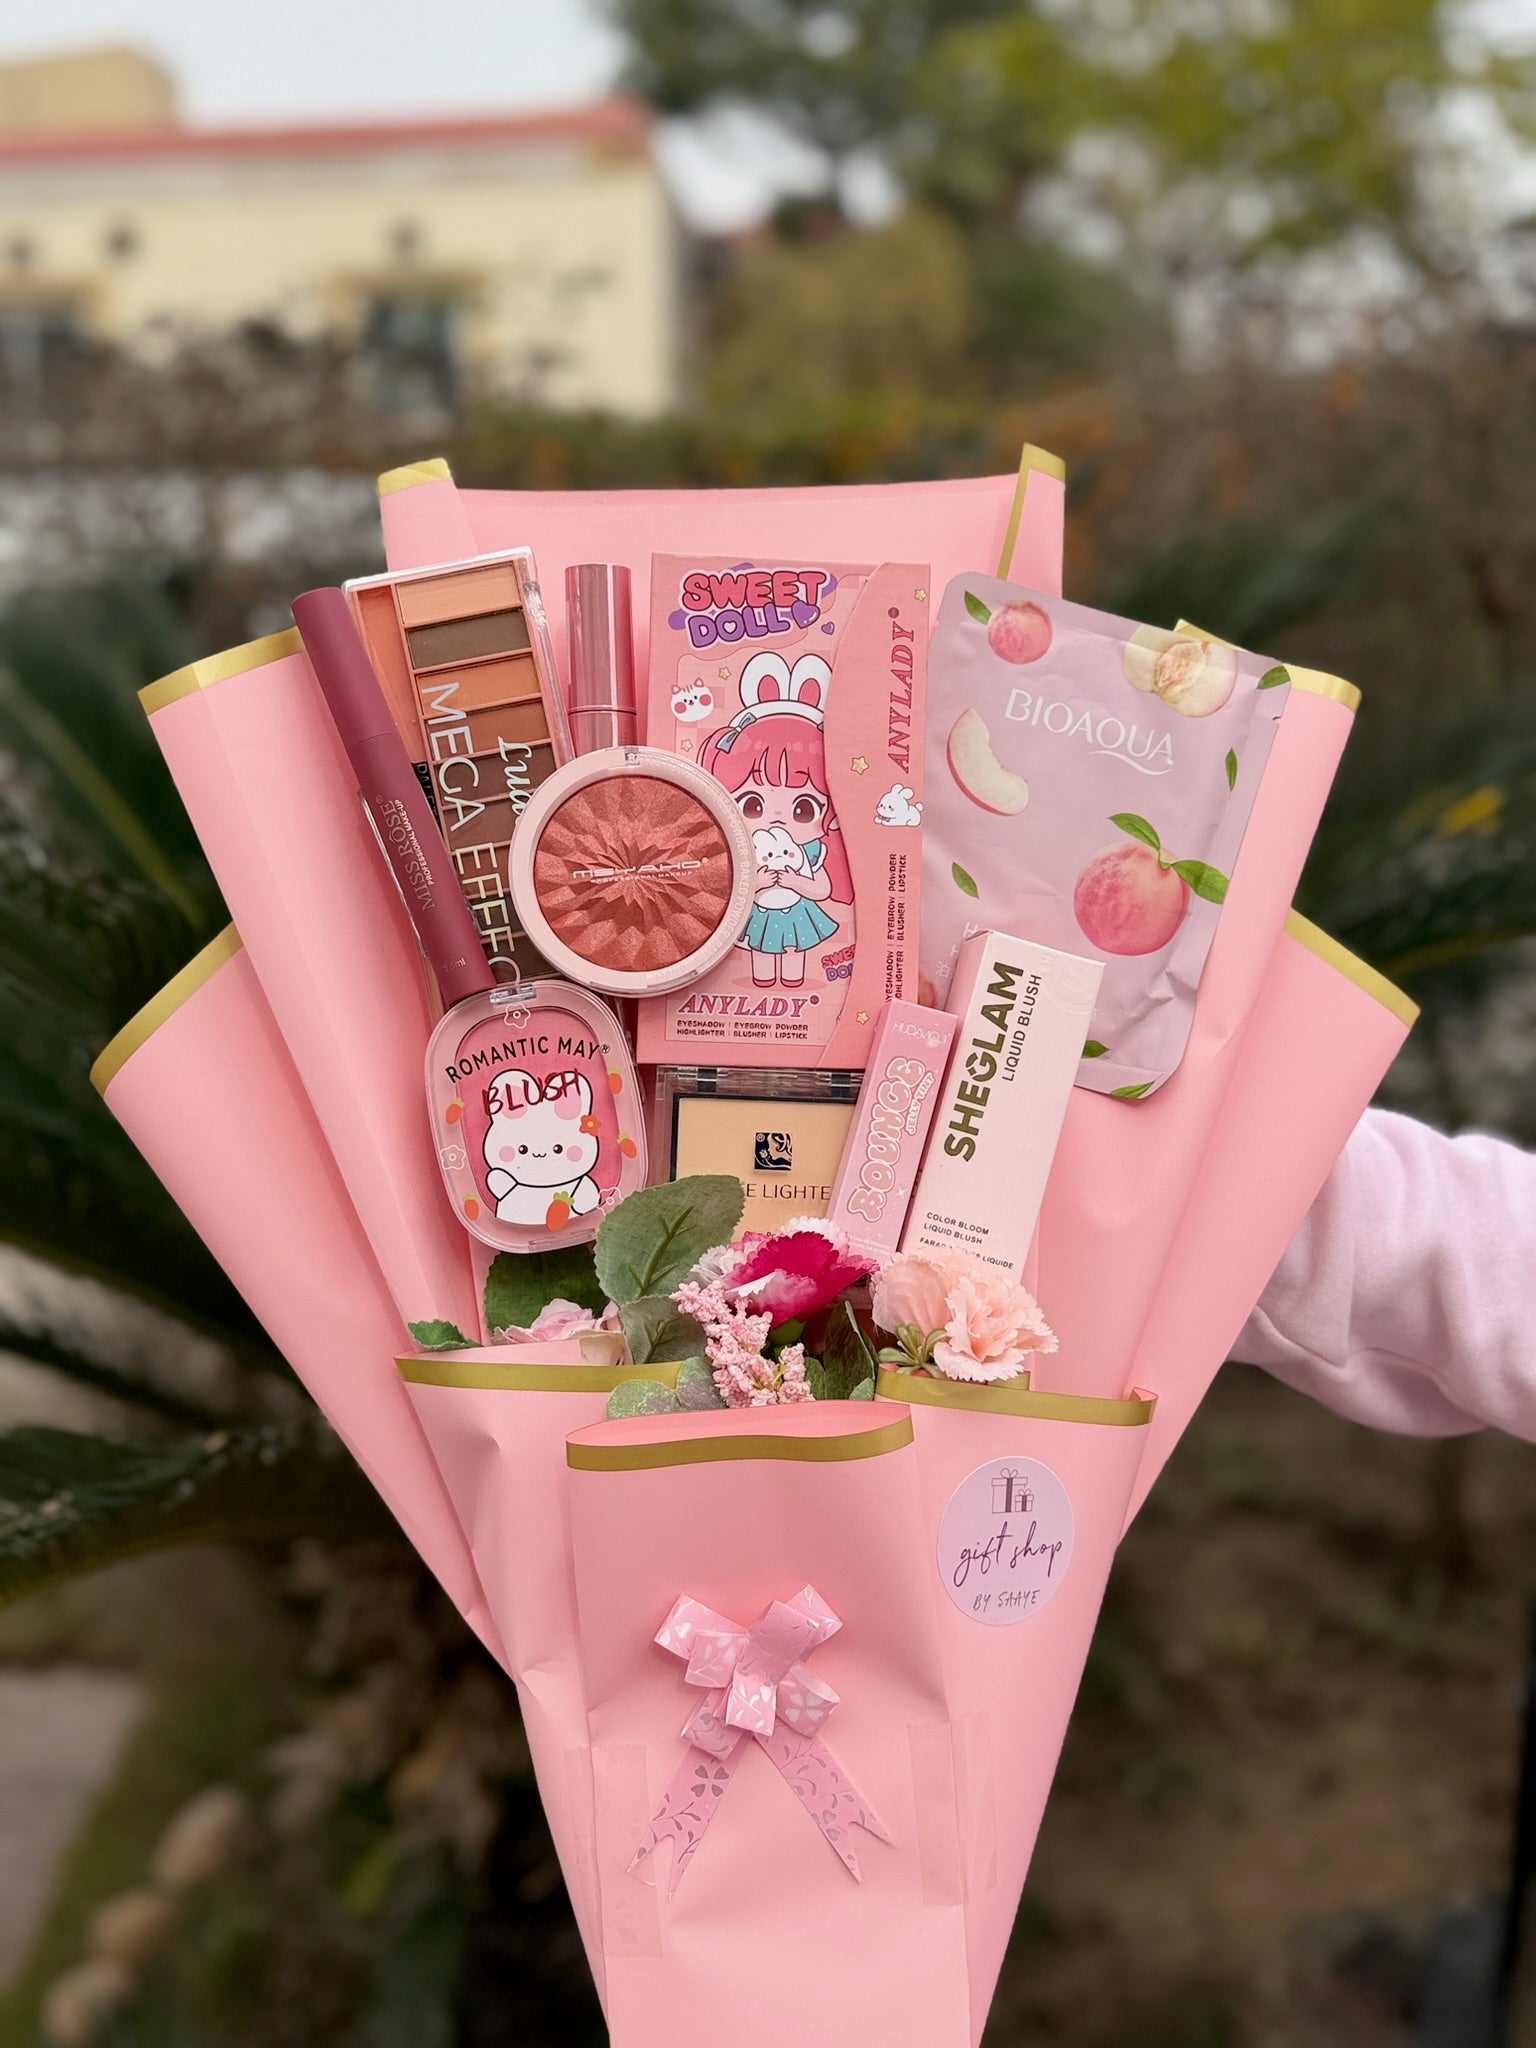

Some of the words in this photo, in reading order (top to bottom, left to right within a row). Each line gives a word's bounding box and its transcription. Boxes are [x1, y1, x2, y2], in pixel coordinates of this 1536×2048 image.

[682, 571, 827, 611] SWEET
[689, 602, 791, 649] DOLL
[887, 621, 915, 774] ANYLADY
[1004, 688, 1174, 776] BIOAQUA
[421, 682, 486, 832] MEGA
[395, 798, 413, 832] MAKE-UP
[408, 828, 434, 886] PROFESSIONAL
[888, 853, 897, 892] POWDER
[898, 854, 907, 893] LIPSTICK
[405, 861, 436, 912] MISS
[887, 895, 896, 940] EYEBROW
[677, 1019, 725, 1028] EYESHADOW
[734, 1022, 772, 1030] EYEBROW
[775, 1023, 809, 1031] POWDER
[678, 994, 809, 1018] ANYLADY
[1002, 1030, 1026, 1082] LIQUID
[1018, 974, 1042, 1027] BLUSH
[677, 1028, 725, 1037] HIGHLIGHTER
[733, 1030, 767, 1038] BLUSHER
[775, 1032, 808, 1040] LIPSTICK
[445, 1036, 550, 1084] ROMANTIC
[944, 961, 1024, 1162] SHEGLAM
[482, 1068, 581, 1116] BLUSH
[907, 1099, 921, 1134] JELLY
[914, 1073, 935, 1099] TINT
[848, 1056, 926, 1223] BOUNCE
[923, 1223, 953, 1236] LIQUID
[954, 1232, 983, 1245] BLUSH
[926, 1212, 957, 1226] COLOR
[958, 1221, 990, 1236] BLOOM
[982, 1255, 1014, 1270] LIQUIDE
[953, 1521, 1014, 1588] gift
[1010, 1520, 1063, 1578] shop
[973, 1594, 992, 1612] BY
[998, 1589, 1041, 1610] SAAYE
